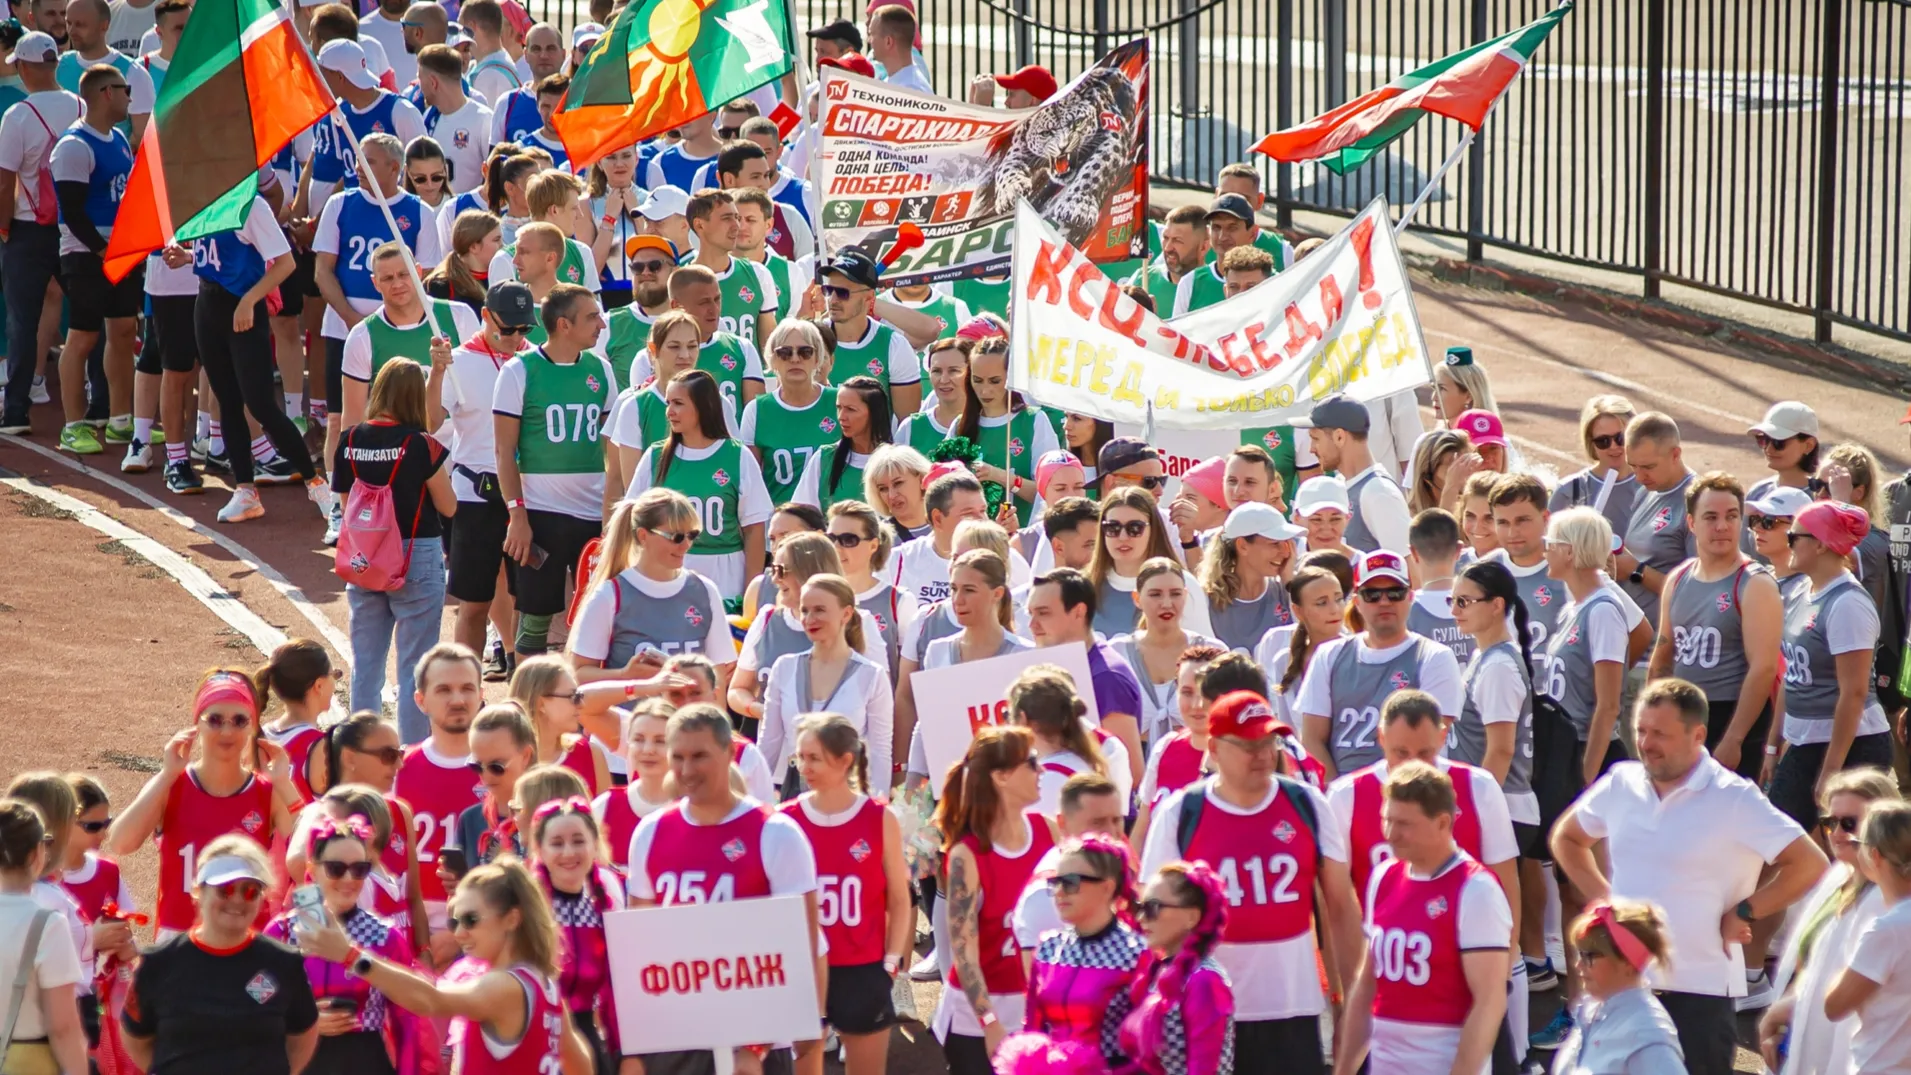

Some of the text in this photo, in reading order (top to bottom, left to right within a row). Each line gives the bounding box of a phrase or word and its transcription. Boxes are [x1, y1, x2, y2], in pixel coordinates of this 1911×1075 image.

[852, 89, 947, 112] ТЕХНОНИКОЛЬ
[835, 162, 909, 175] ОДНА ЦЕЛЬ!
[838, 150, 928, 164] ОДНА КОМАНДА!
[829, 173, 932, 195] ПОБЕДА!
[1028, 330, 1145, 408] ПЕРЁД
[1154, 385, 1180, 410] И
[546, 403, 600, 442] 078
[1218, 853, 1300, 907] 412
[640, 953, 786, 996] ФОРСАЖ
